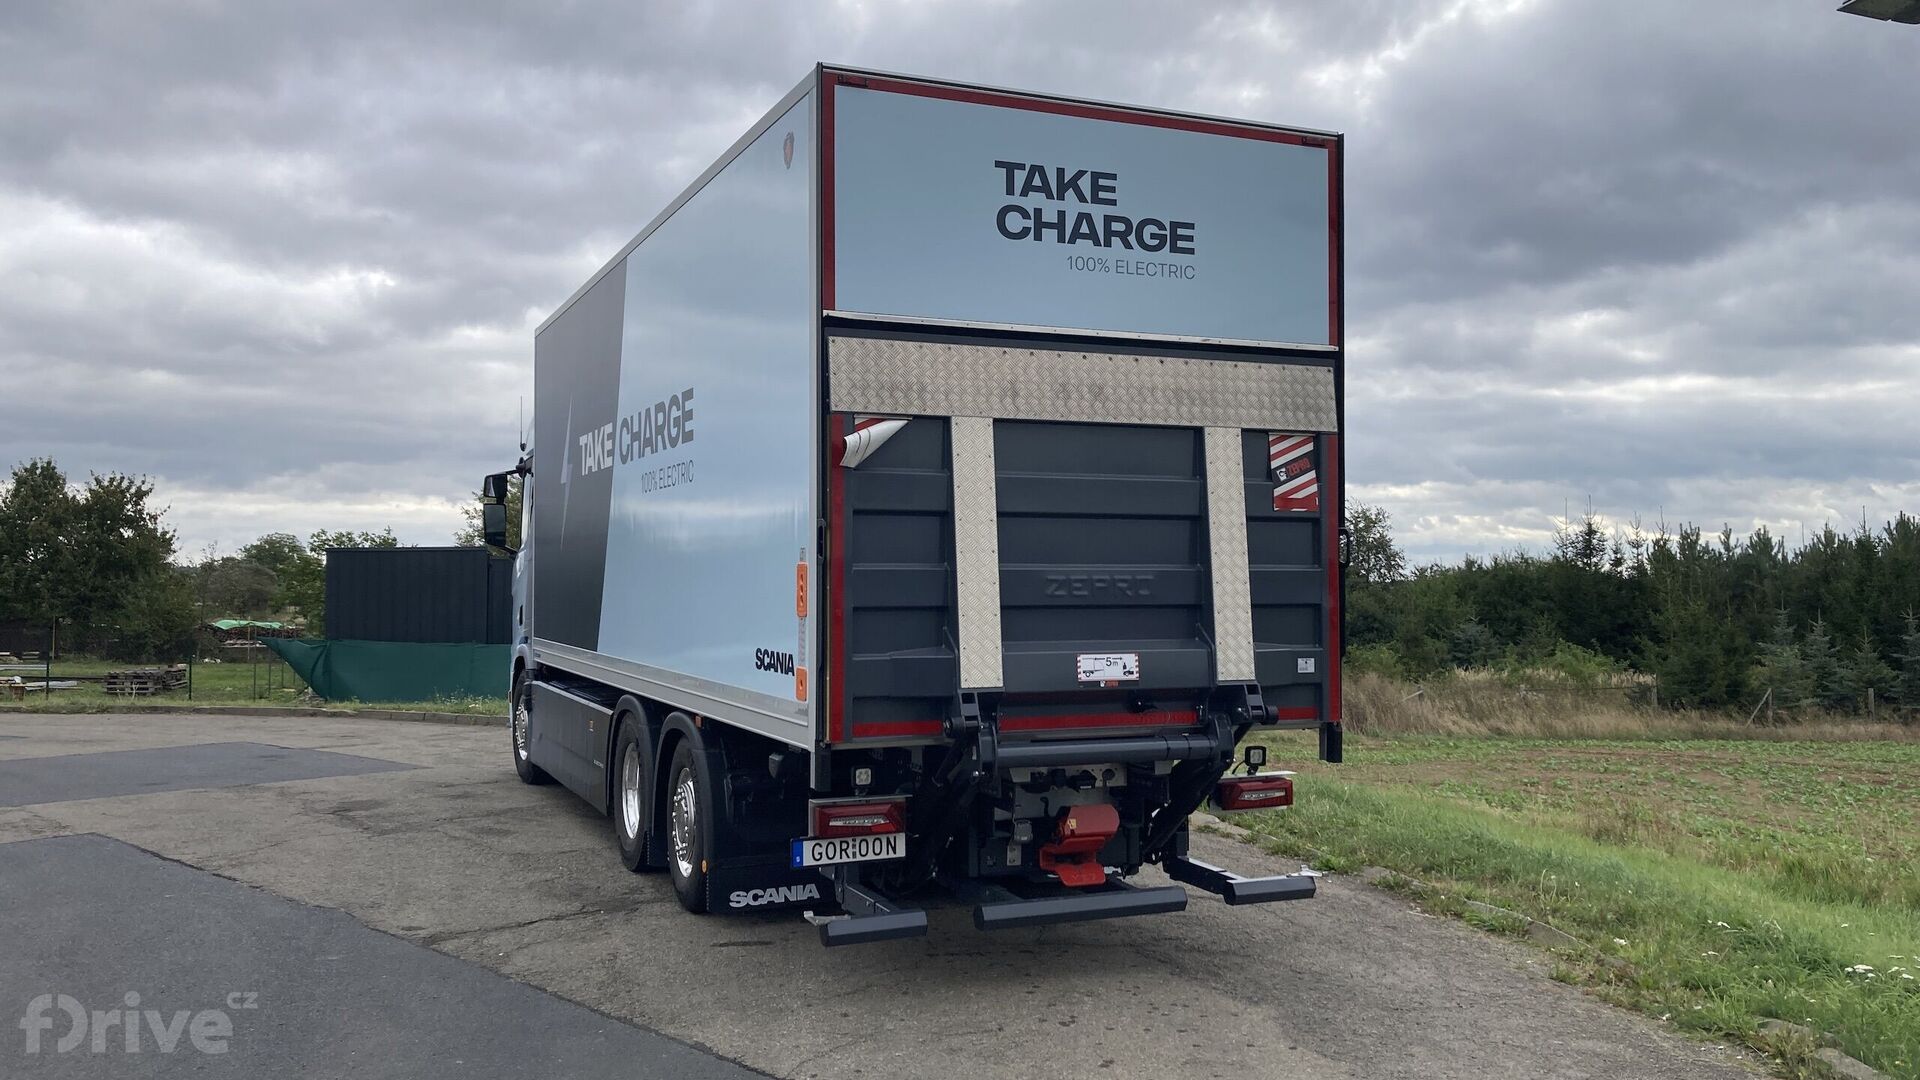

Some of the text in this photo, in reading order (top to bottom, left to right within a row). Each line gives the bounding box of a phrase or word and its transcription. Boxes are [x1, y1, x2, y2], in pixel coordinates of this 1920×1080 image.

[994, 160, 1118, 207] TAKE
[996, 204, 1195, 254] CHARGE
[1066, 255, 1196, 281] 100% ELECTRIC
[579, 387, 694, 476] TAKE CHARGE
[640, 460, 695, 494] 100% ELECTRIC
[755, 647, 795, 677] SCANIA
[1105, 656, 1112, 667] 5
[729, 883, 820, 908] SCANIA
